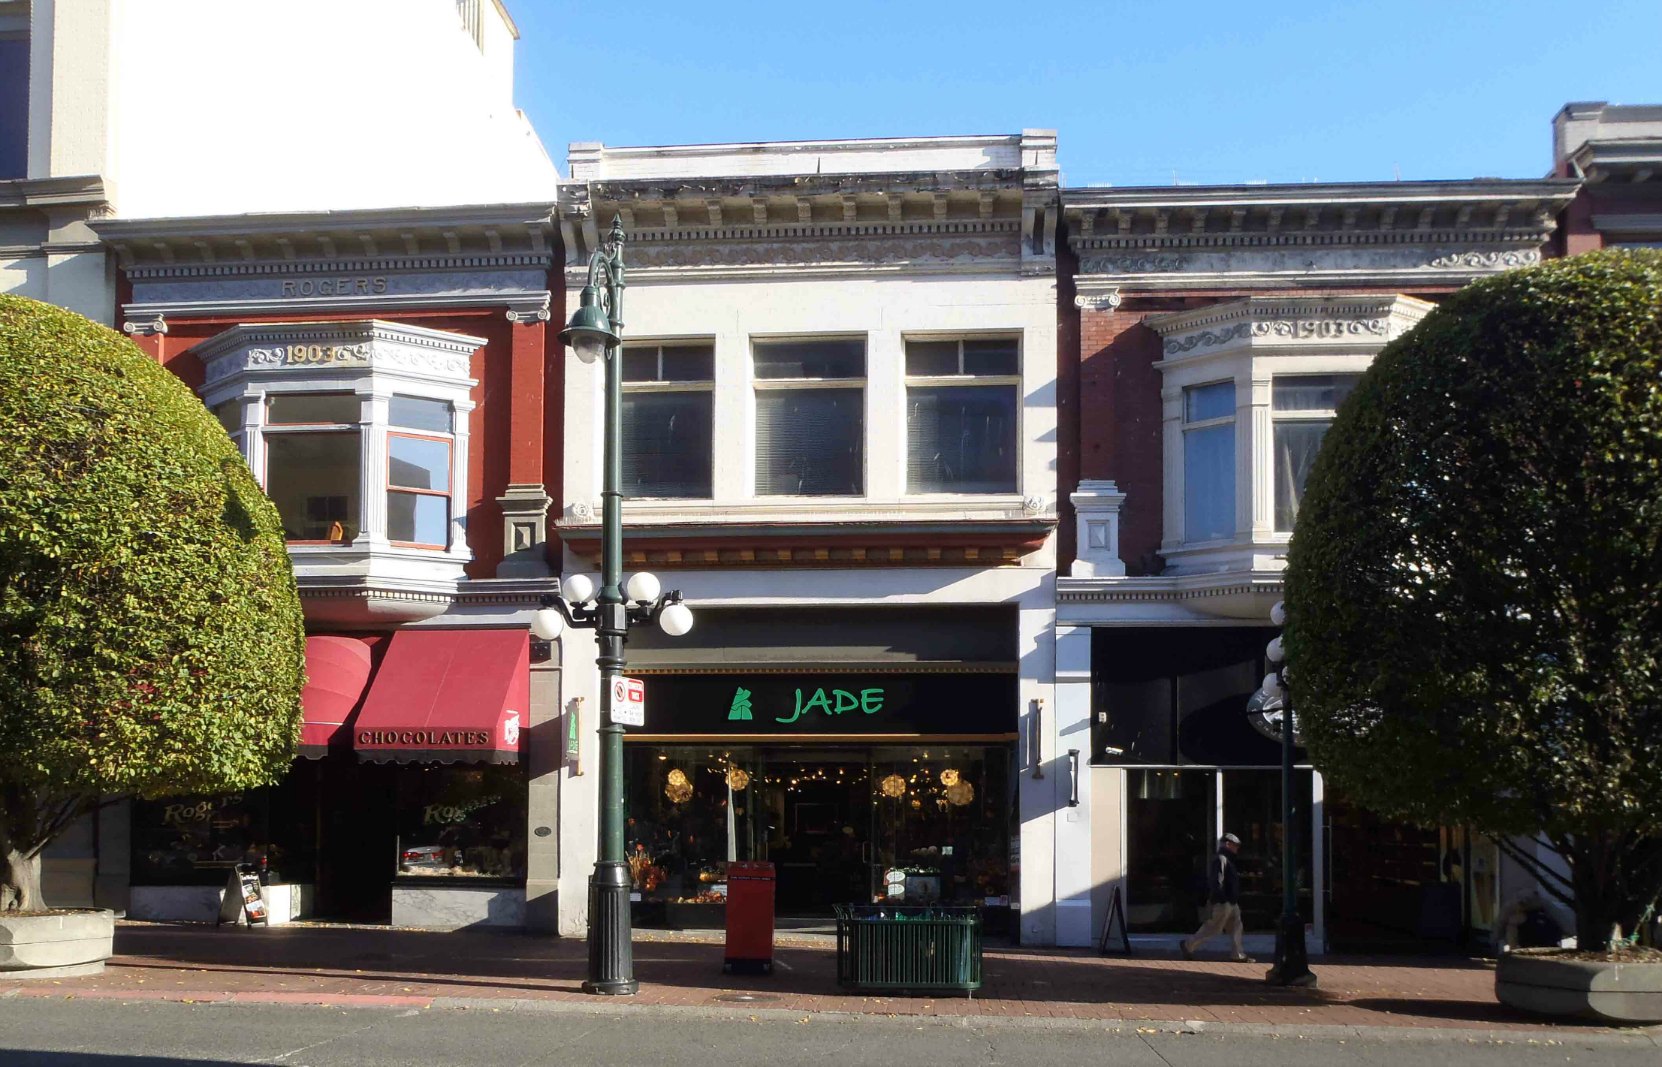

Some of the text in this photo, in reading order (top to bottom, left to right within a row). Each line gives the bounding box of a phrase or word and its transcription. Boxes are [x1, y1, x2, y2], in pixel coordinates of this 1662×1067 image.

[281, 277, 387, 297] ROGERS
[1292, 319, 1346, 339] 1903
[286, 344, 335, 364] 1903
[775, 687, 885, 724] JADE
[359, 729, 489, 746] CHOCOLATES
